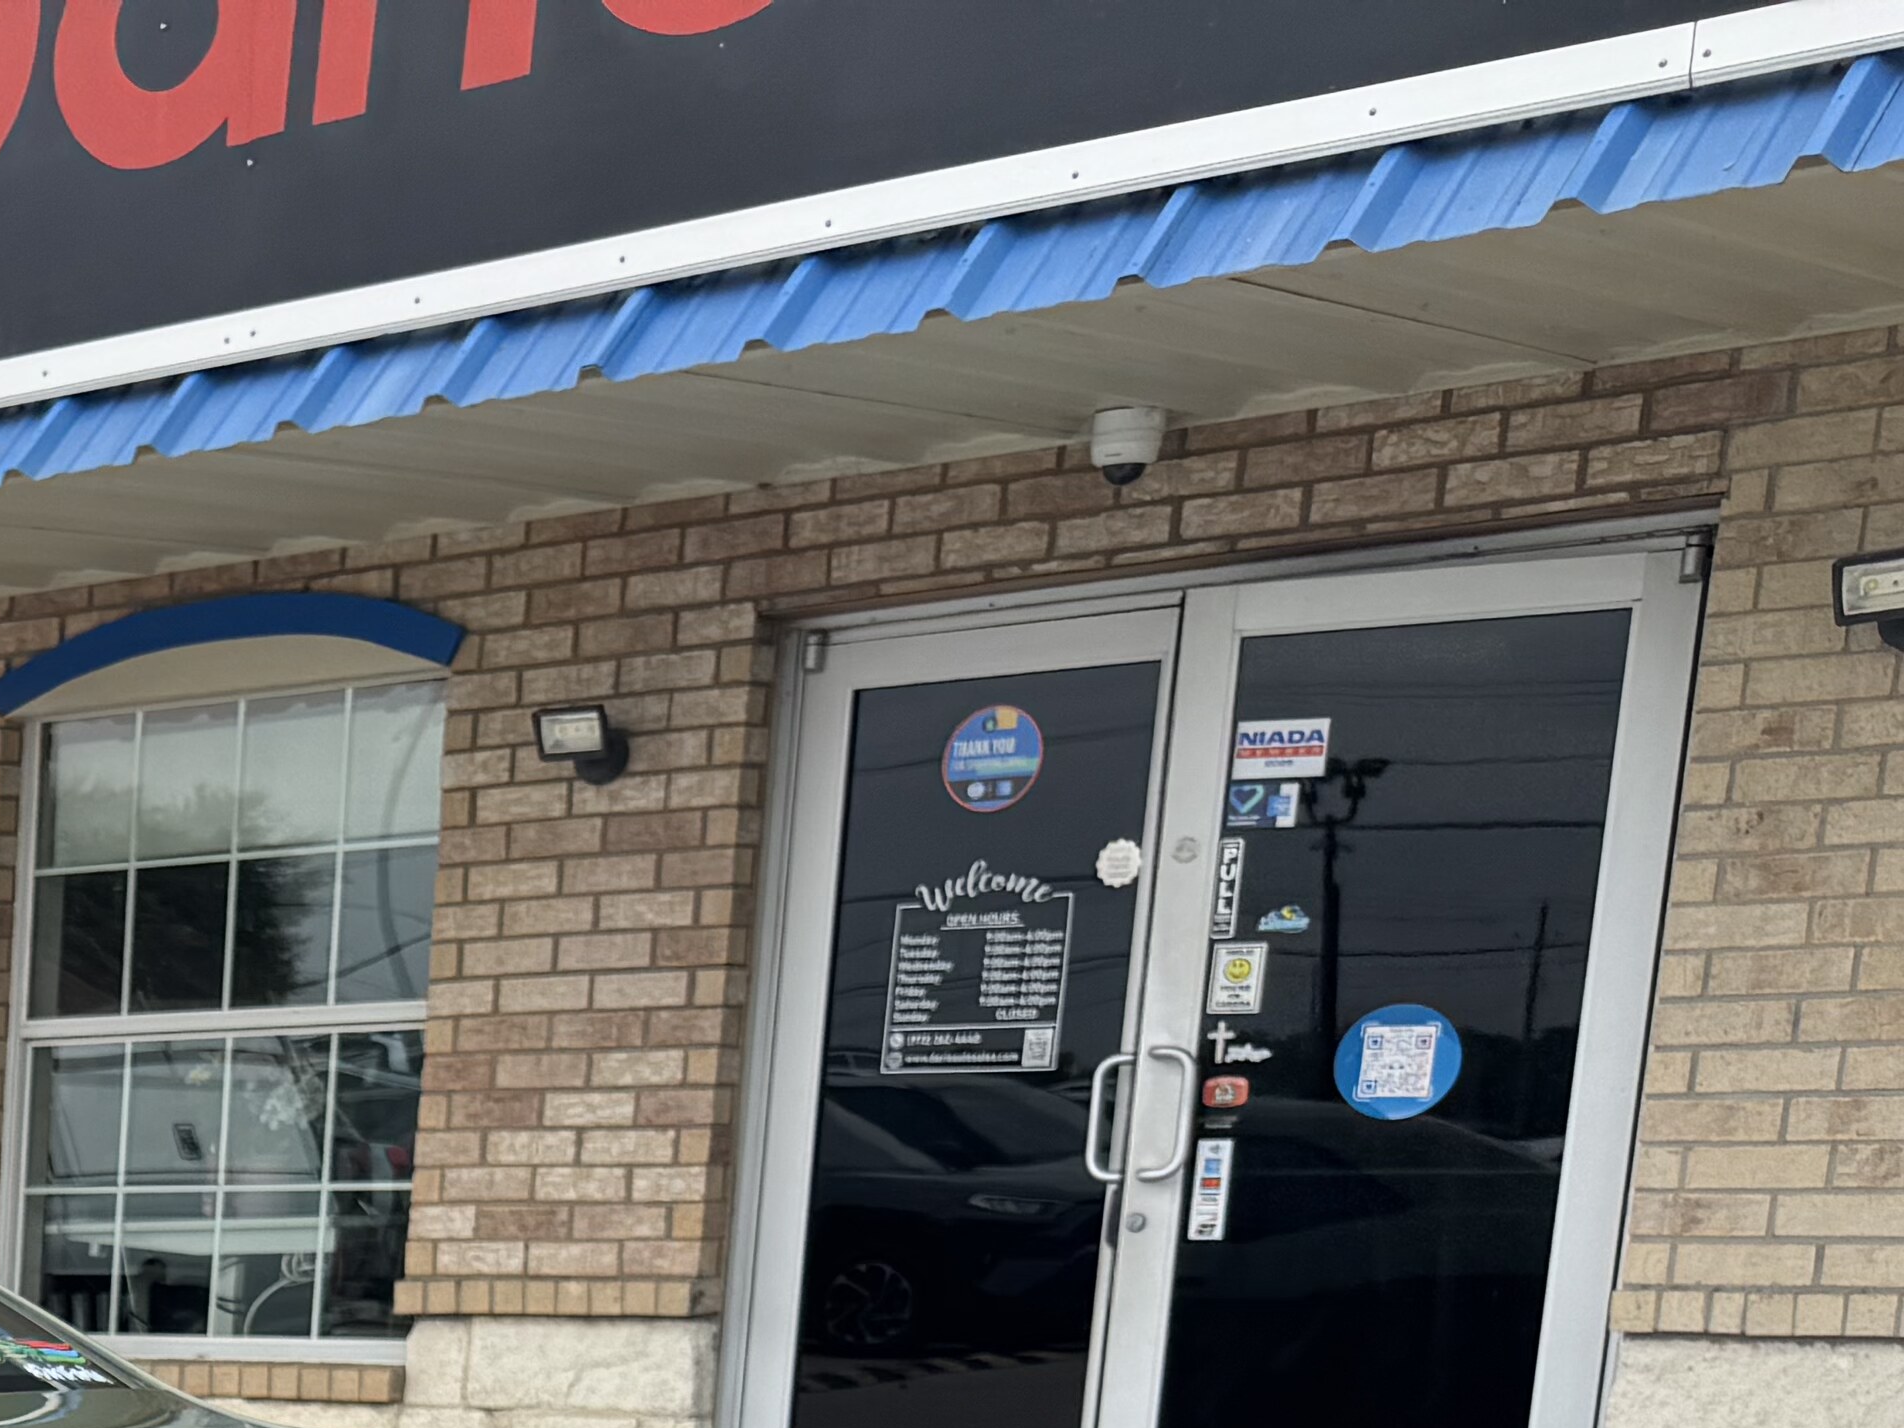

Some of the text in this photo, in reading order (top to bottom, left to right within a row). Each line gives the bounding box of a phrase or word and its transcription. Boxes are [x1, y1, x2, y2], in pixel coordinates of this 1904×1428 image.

[953, 737, 1016, 758] THANK YOU
[1238, 729, 1325, 747] NIADA
[915, 858, 1053, 912] Welcome
[1216, 847, 1239, 915] PULL
[946, 911, 1021, 927] OPEN HOURS
